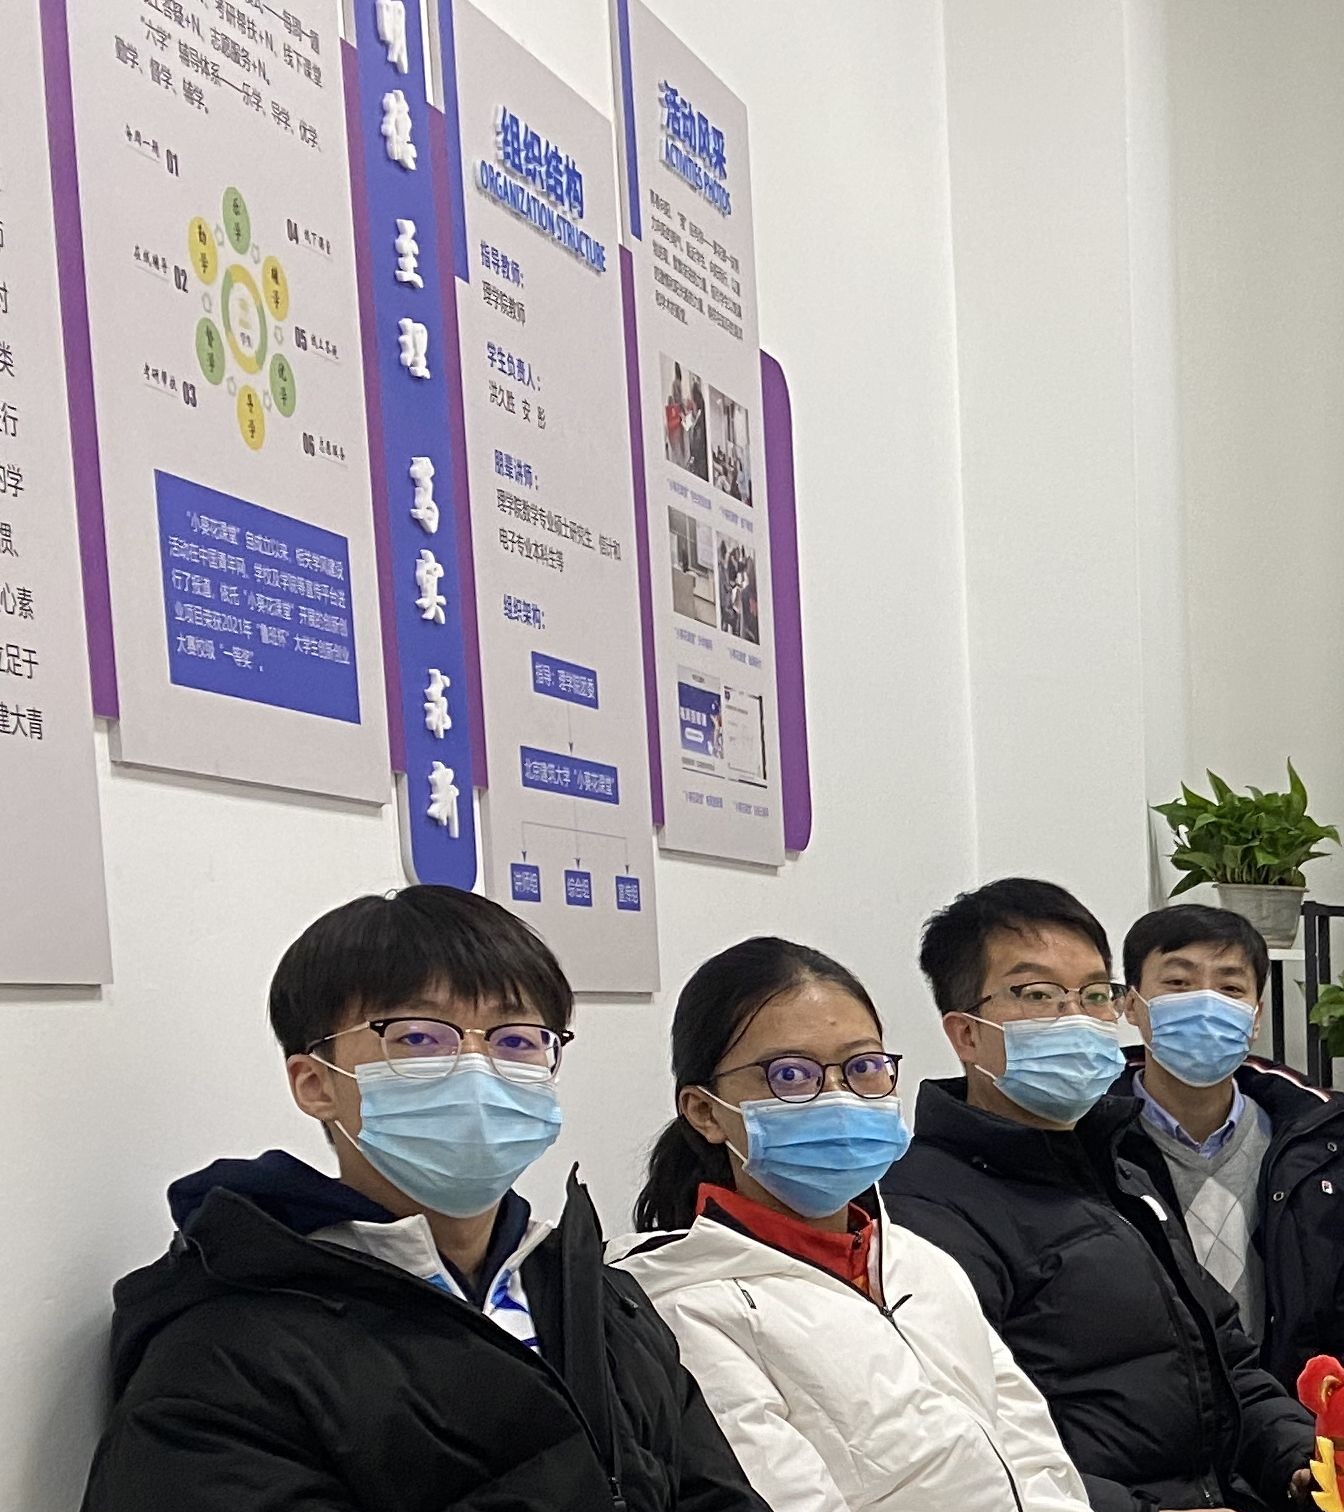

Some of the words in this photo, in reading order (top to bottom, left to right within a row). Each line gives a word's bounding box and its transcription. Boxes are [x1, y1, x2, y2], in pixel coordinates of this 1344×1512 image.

[498, 104, 585, 220] 组织结构
[662, 80, 728, 181] 活动风采
[479, 159, 556, 236] ORGANIZATION
[555, 212, 607, 273] STRUCTURE
